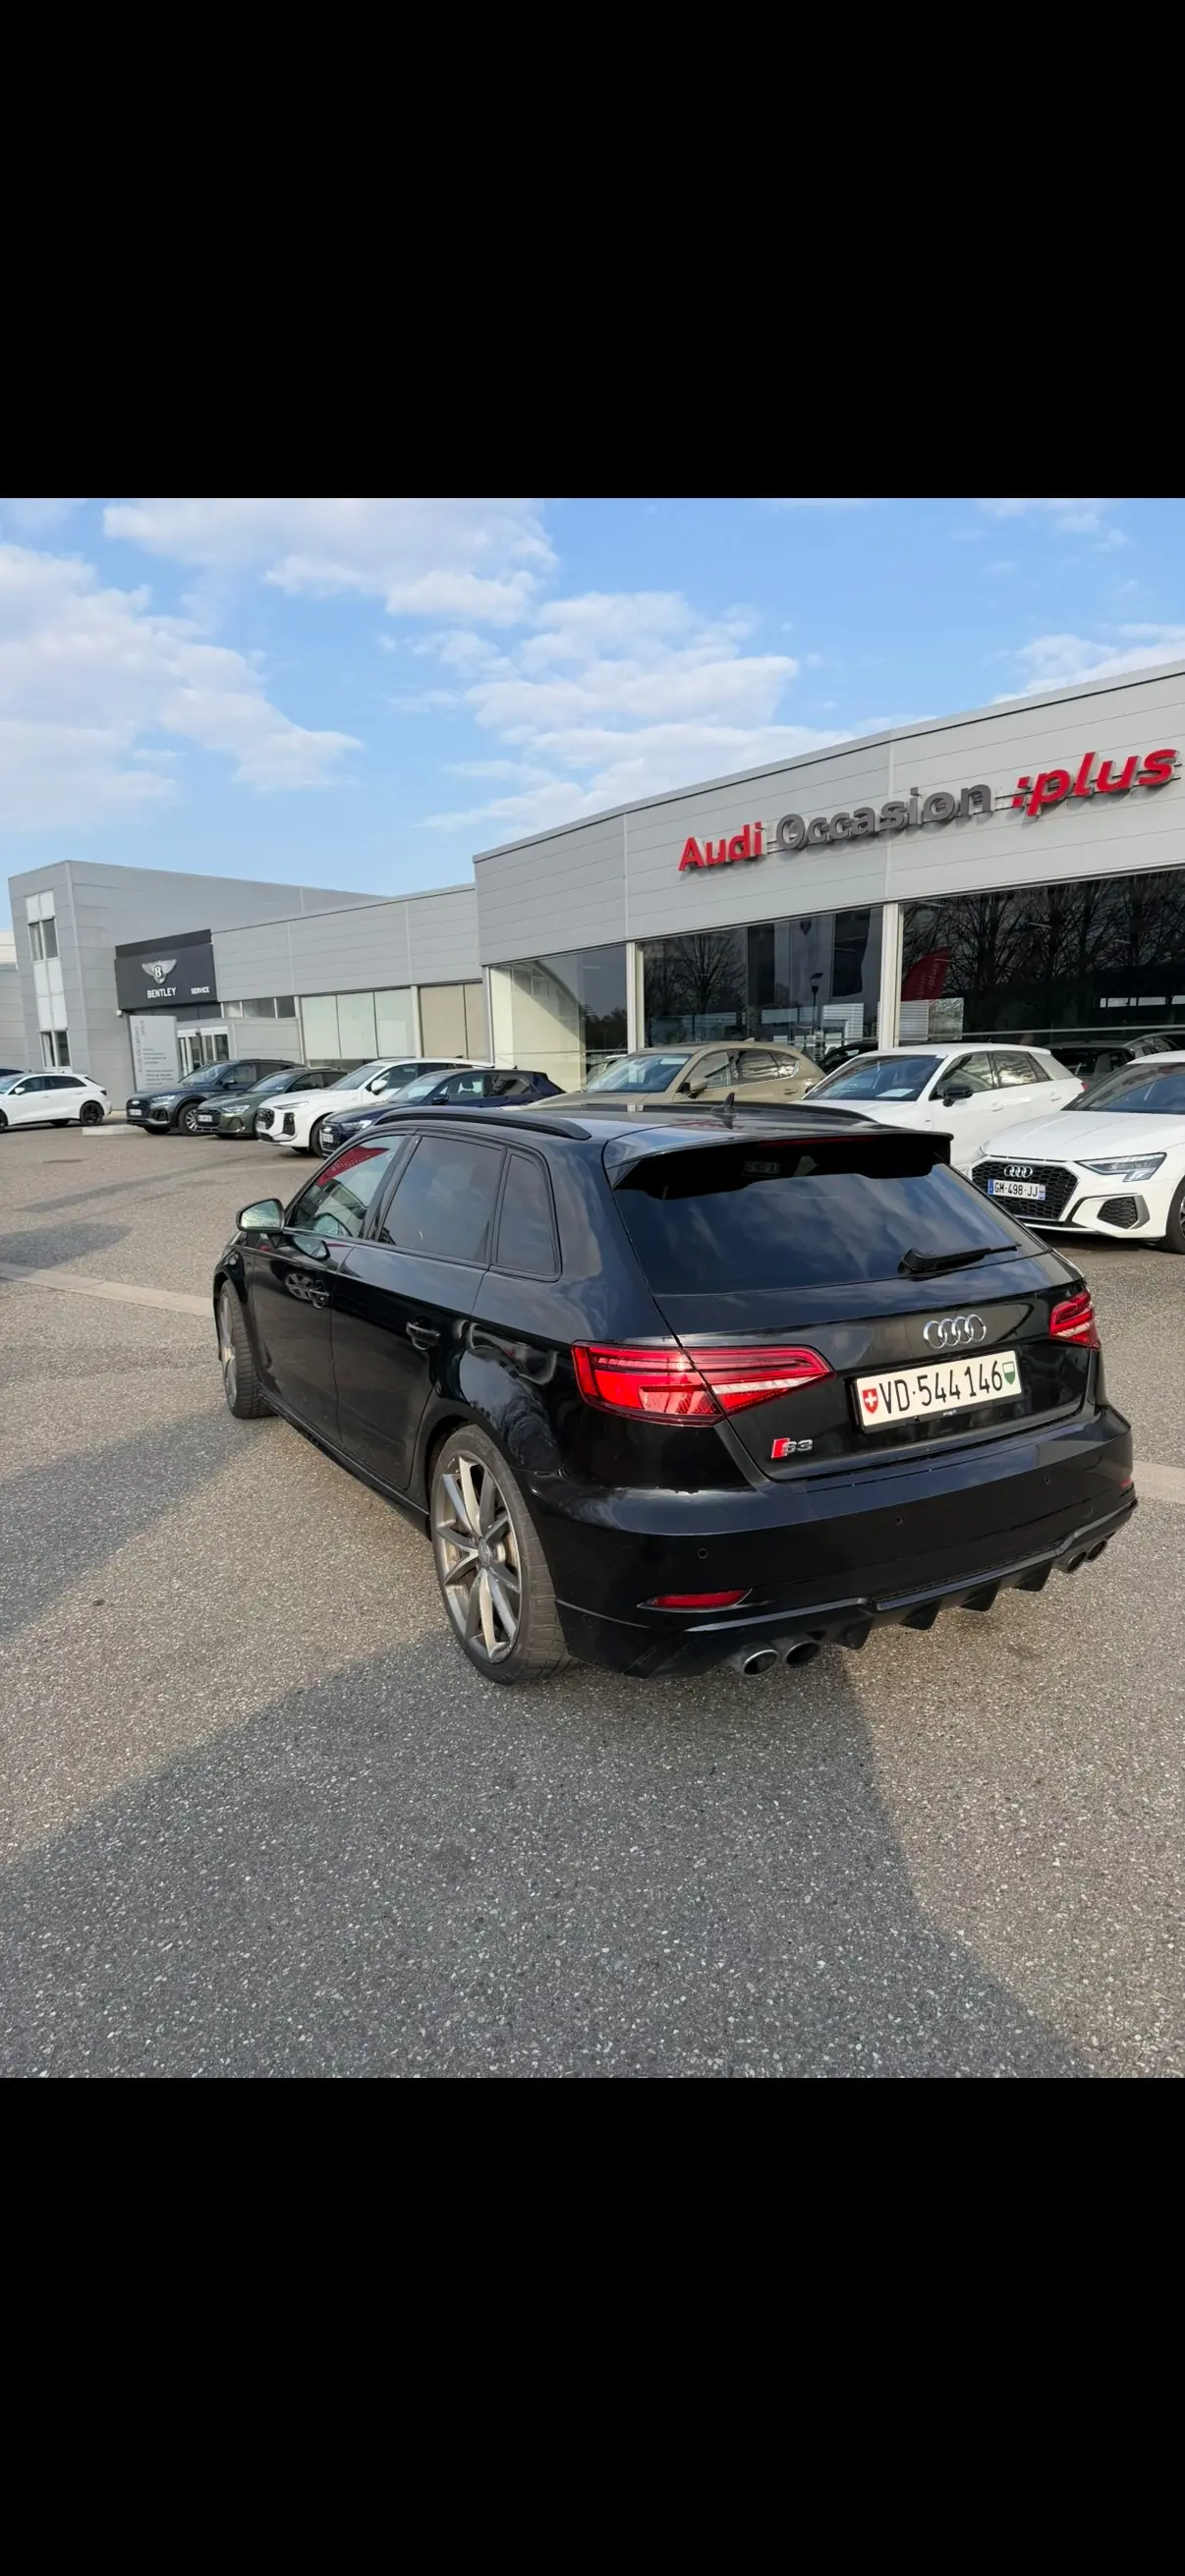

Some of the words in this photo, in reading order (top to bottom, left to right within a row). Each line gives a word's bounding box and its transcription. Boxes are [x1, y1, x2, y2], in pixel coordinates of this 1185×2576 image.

[678, 821, 763, 871] Audi
[775, 783, 992, 851] Occasion
[146, 986, 177, 999] BENTLEY
[190, 985, 210, 995] SERVICE
[994, 1182, 1039, 1198] GM-498-JJ
